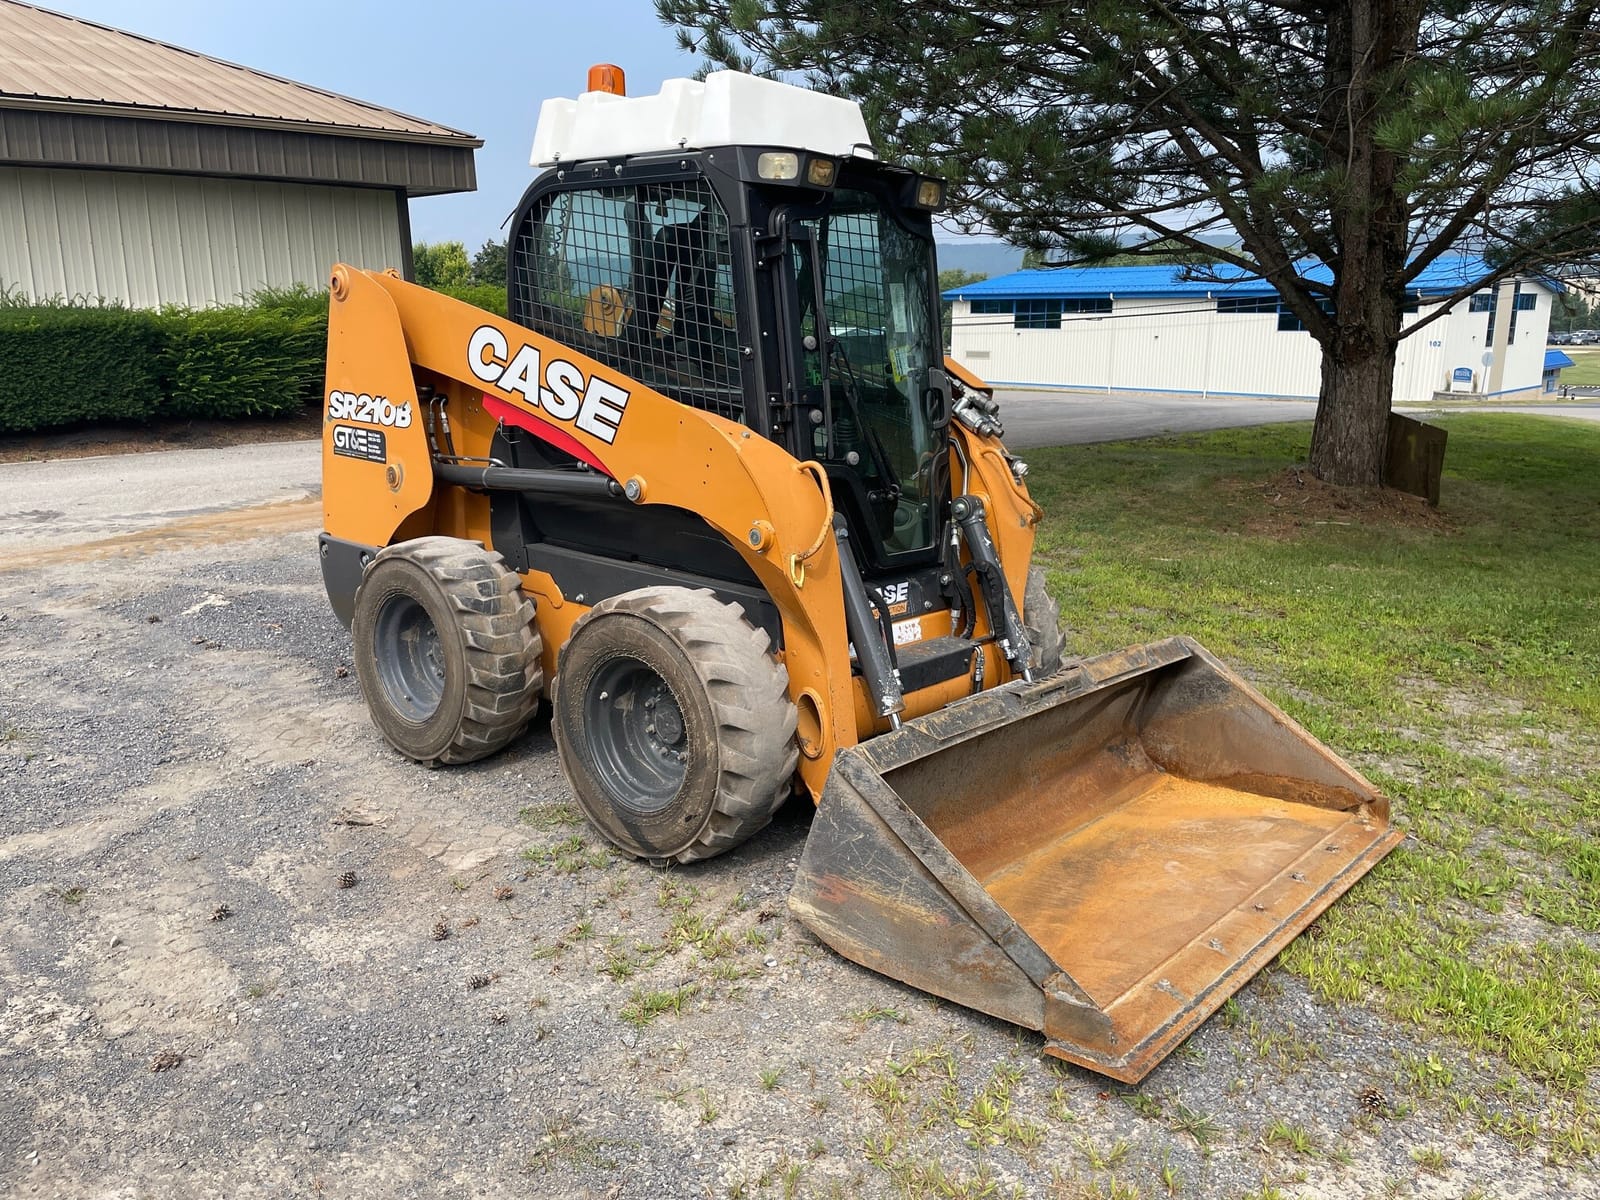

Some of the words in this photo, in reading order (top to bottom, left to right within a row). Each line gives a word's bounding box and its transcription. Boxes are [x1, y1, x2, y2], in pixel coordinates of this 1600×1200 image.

[467, 325, 630, 445] CASE
[328, 390, 412, 428] SR210B
[333, 425, 368, 452] GT&E
